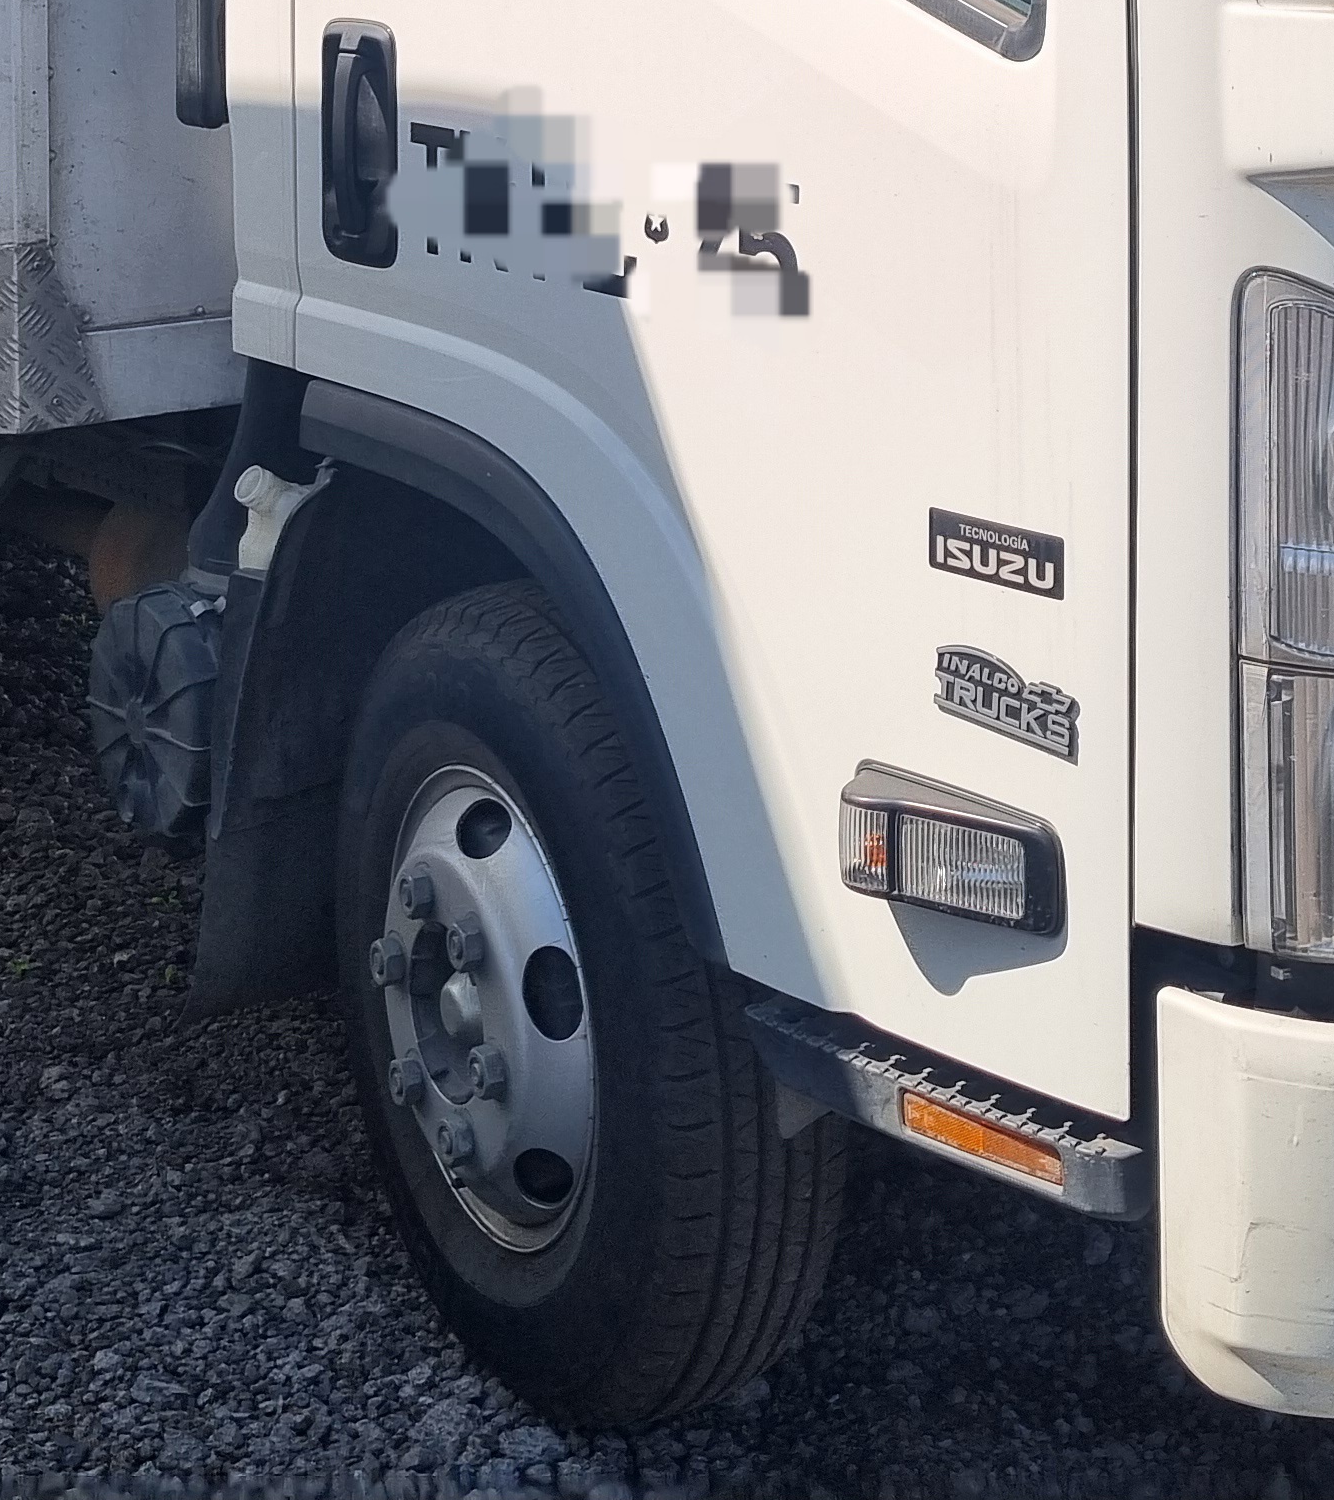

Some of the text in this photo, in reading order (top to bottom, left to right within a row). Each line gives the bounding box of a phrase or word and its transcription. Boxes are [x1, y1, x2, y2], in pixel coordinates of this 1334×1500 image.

[935, 534, 1055, 590] ISUZU
[958, 523, 1030, 552] TECNOLOGÍA
[942, 653, 1019, 695] INALCO
[935, 670, 1070, 748] TRUCKS
